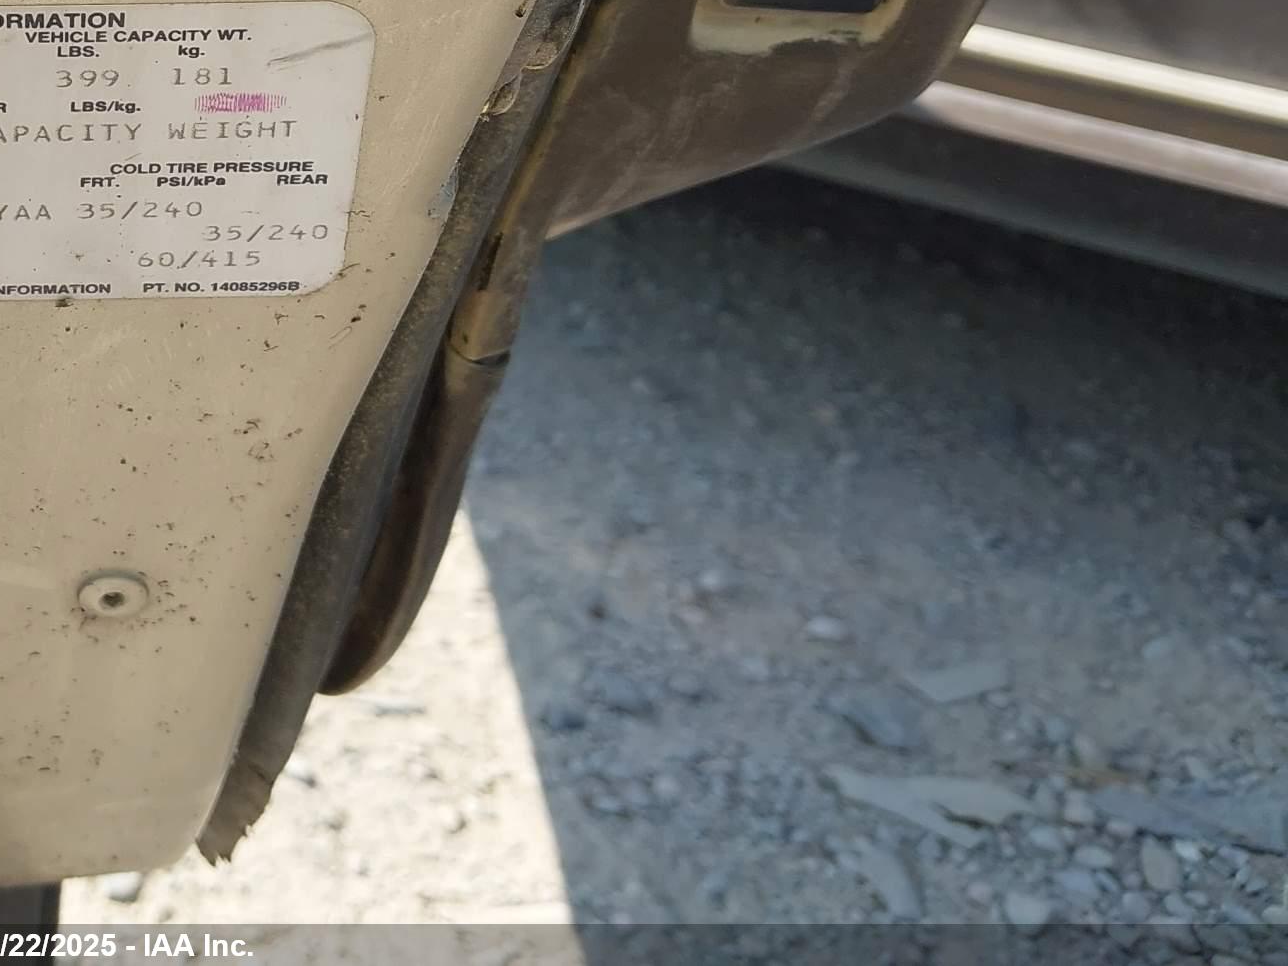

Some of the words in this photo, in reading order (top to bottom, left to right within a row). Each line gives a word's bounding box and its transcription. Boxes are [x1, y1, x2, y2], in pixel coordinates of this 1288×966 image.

[25, 30, 108, 44] VEHICLE
[114, 29, 212, 43] CAPACITY
[217, 28, 252, 42] WT.
[57, 45, 100, 59] LBS.
[178, 45, 206, 59] kg.
[56, 69, 120, 88] 399
[173, 67, 233, 86] 181
[70, 101, 142, 115] LBS/kg.
[167, 120, 299, 140] WEIGHT
[110, 162, 163, 175] COLD
[166, 162, 209, 174] TIRE
[214, 161, 314, 173] PRESSURE
[80, 176, 120, 188] FRT.
[157, 175, 226, 188] PSI/kPa
[276, 174, 329, 186] REAR
[76, 200, 203, 221] 35/240
[203, 224, 330, 243] 35/240
[137, 250, 262, 270] 60/415
[143, 282, 170, 293] PT.
[174, 282, 205, 293] NO.
[210, 281, 301, 292] 14085296B
